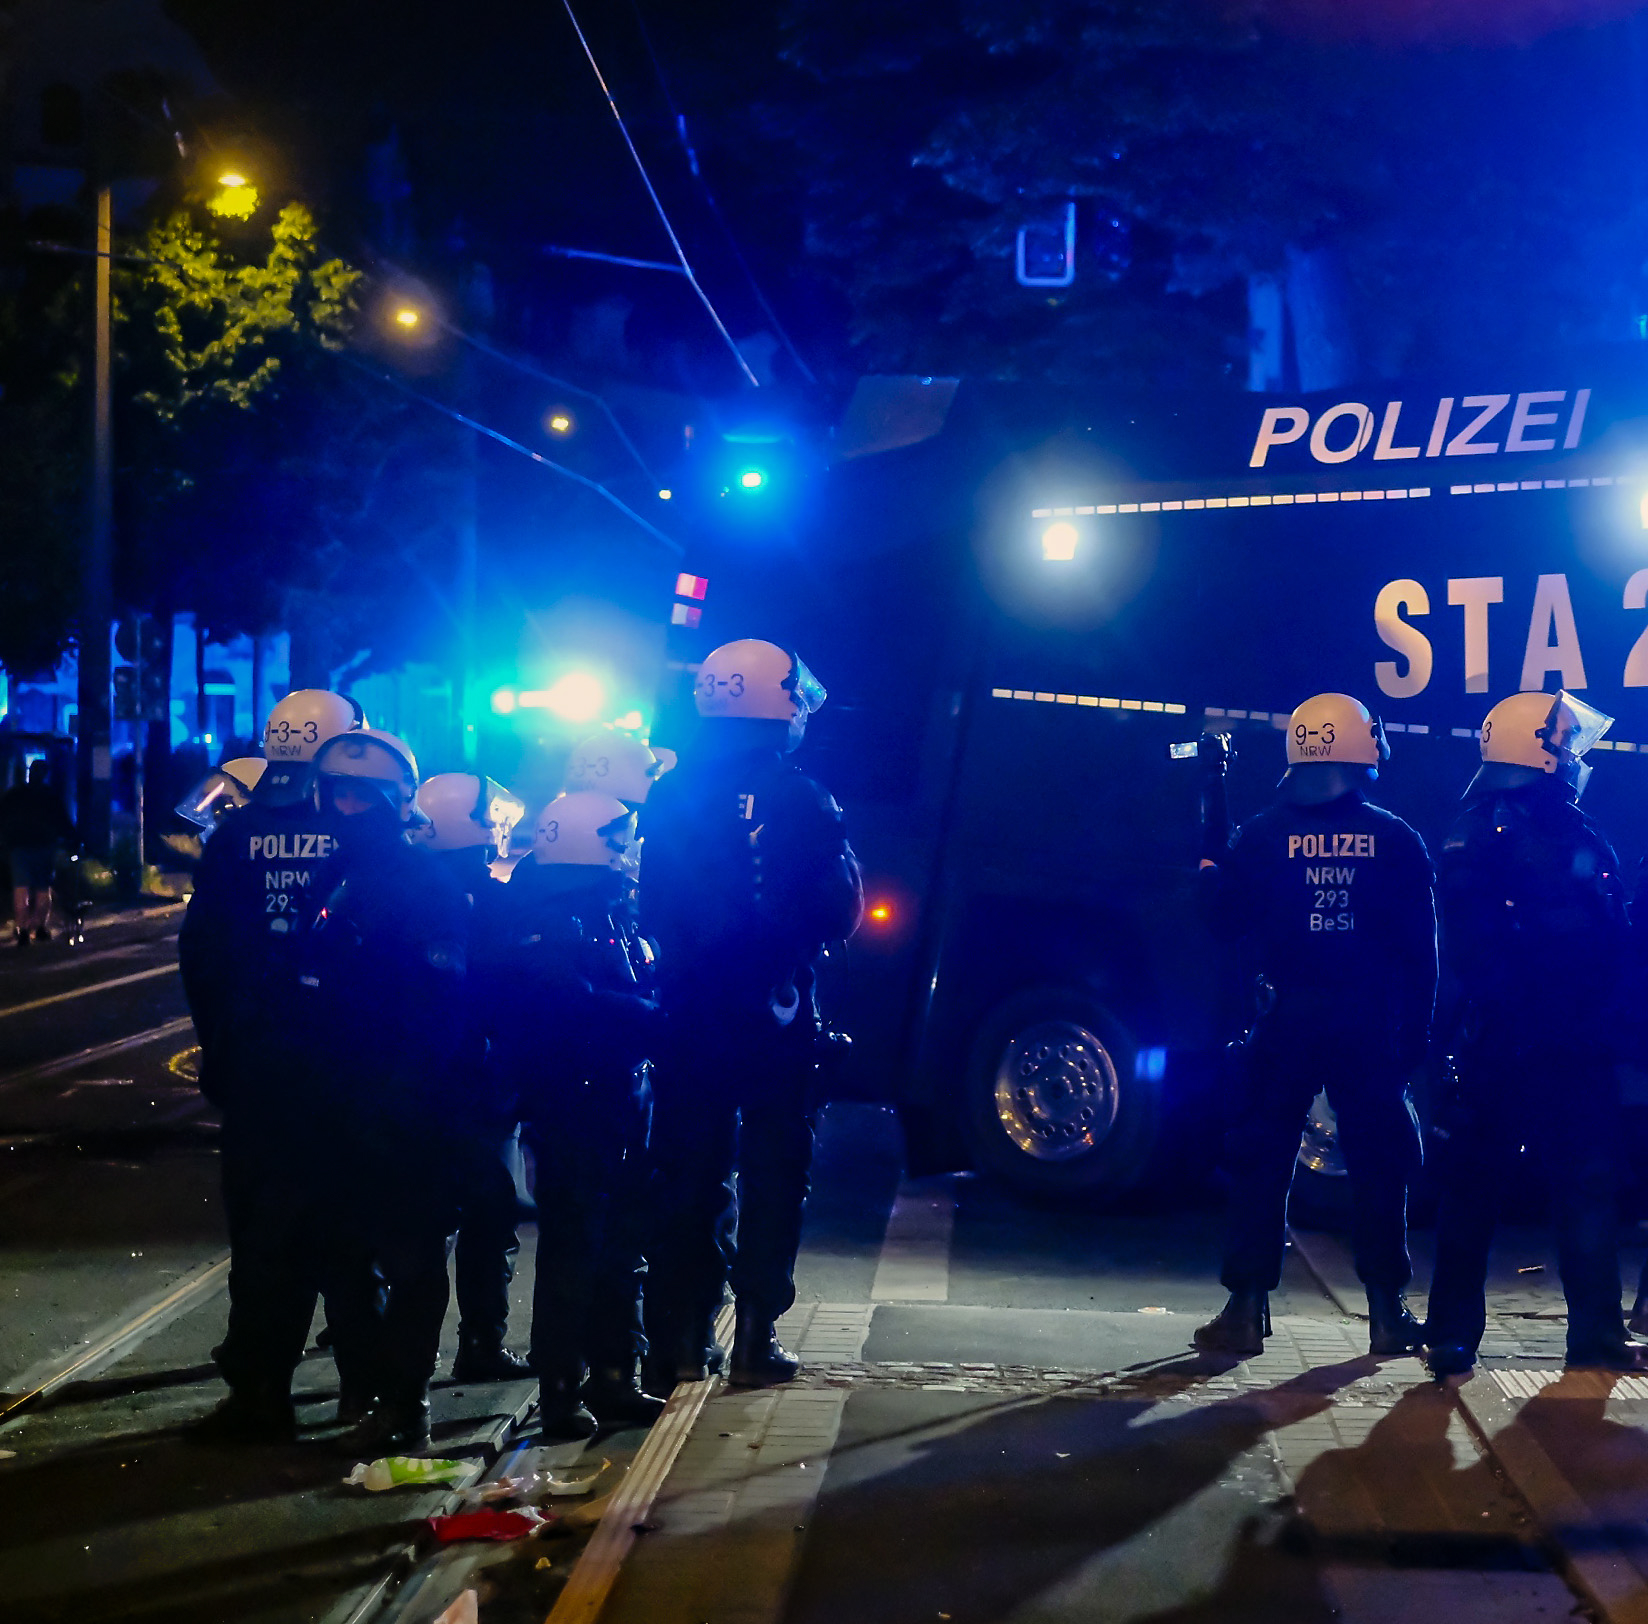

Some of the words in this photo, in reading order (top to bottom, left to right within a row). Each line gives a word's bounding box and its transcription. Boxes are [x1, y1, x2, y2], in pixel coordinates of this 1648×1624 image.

[1249, 388, 1592, 468] POLIZEI
[1374, 573, 1588, 698] STA
[1295, 722, 1336, 746] 9-3
[272, 745, 302, 757] NRW
[1300, 745, 1332, 758] NRW
[1288, 833, 1376, 859] POLIZEI
[1305, 866, 1356, 886] NRW
[1313, 890, 1349, 910] 293
[1309, 912, 1355, 933] BeSi
